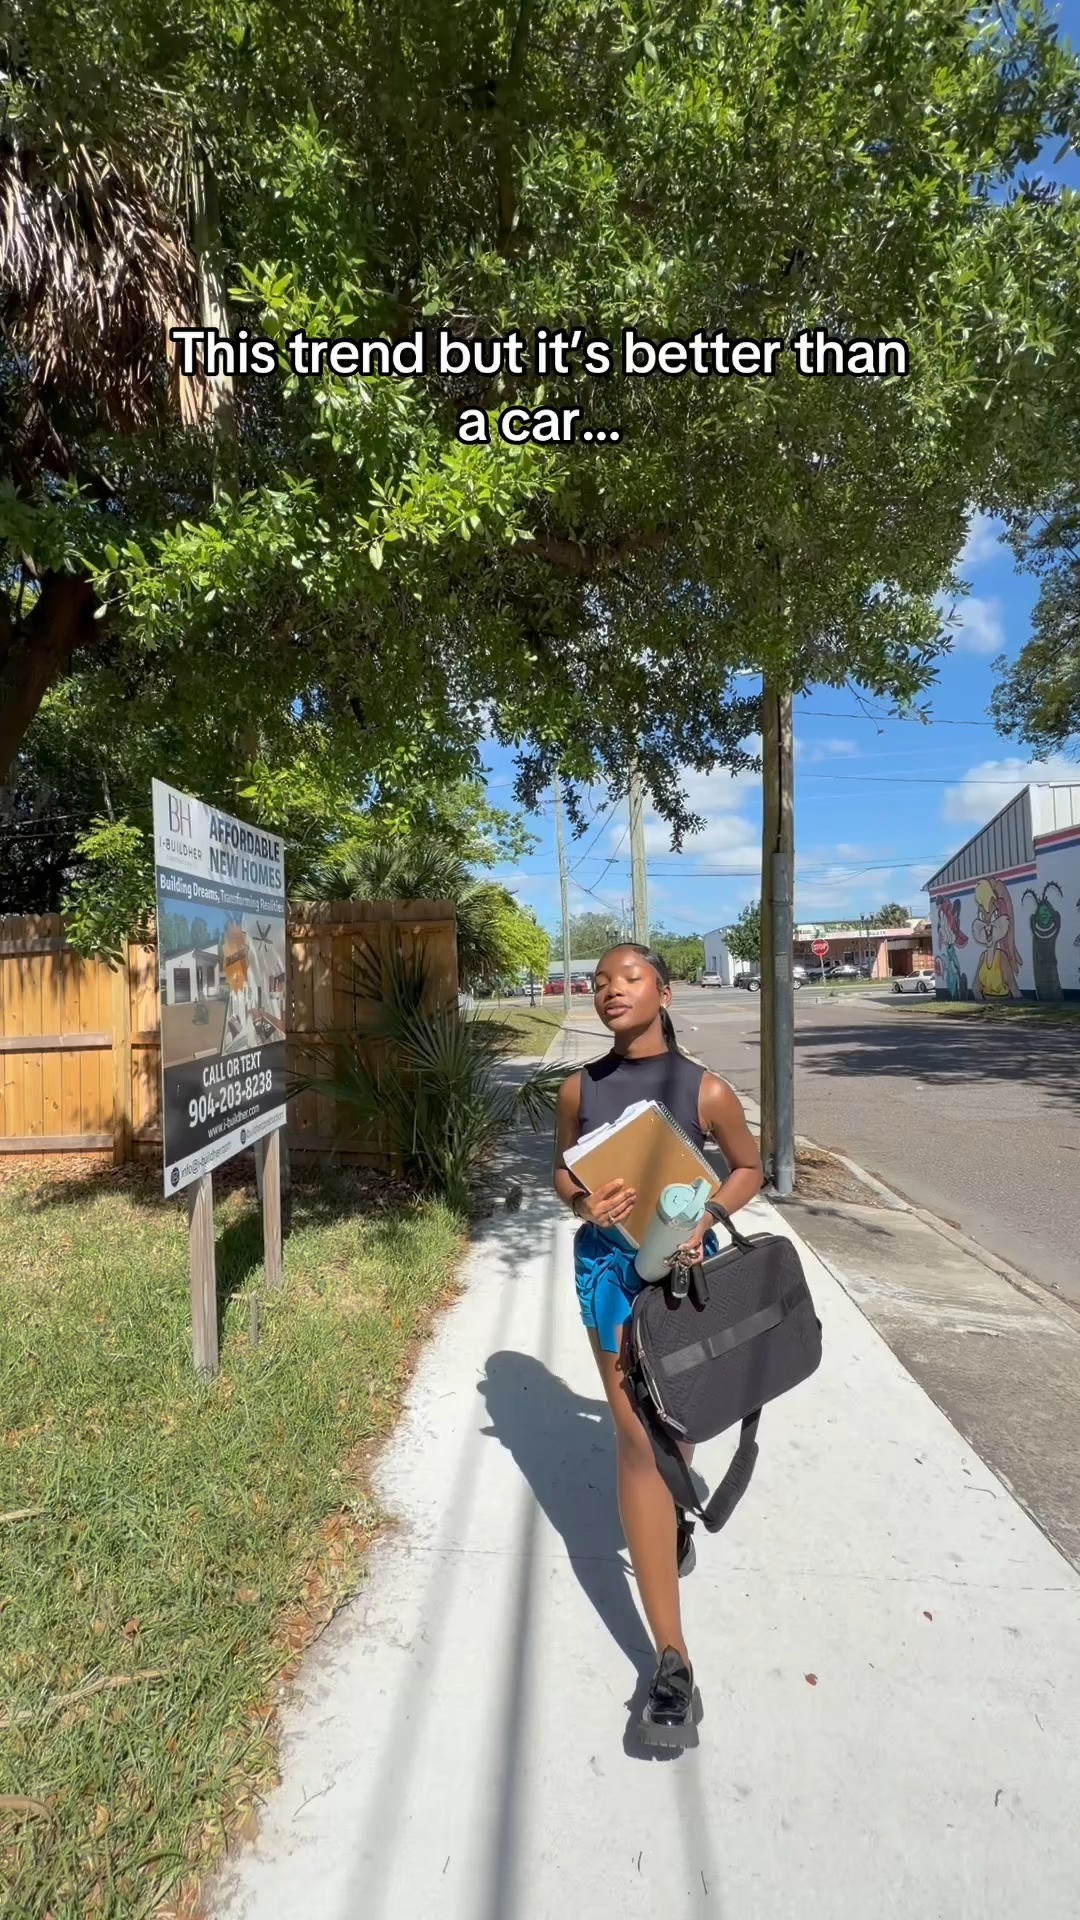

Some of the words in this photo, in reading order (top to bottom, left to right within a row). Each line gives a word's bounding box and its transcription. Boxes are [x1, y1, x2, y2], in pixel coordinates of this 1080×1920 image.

[168, 793, 192, 838] BH
[159, 836, 203, 861] I-BUILDHER
[209, 815, 280, 862] AFFORDABLE
[209, 846, 238, 879] NEW
[241, 858, 281, 889] HOMES
[160, 874, 192, 899] Building
[193, 882, 219, 903] Dreams,
[220, 889, 259, 912] Transforming
[260, 898, 284, 913] Realities
[813, 943, 827, 951] STOP
[203, 1062, 226, 1088] CALL
[226, 1057, 240, 1078] OR
[240, 1050, 262, 1073] TEXT
[188, 1069, 272, 1128] 904-203-8238
[207, 1104, 260, 1139] www.i-buildher.com
